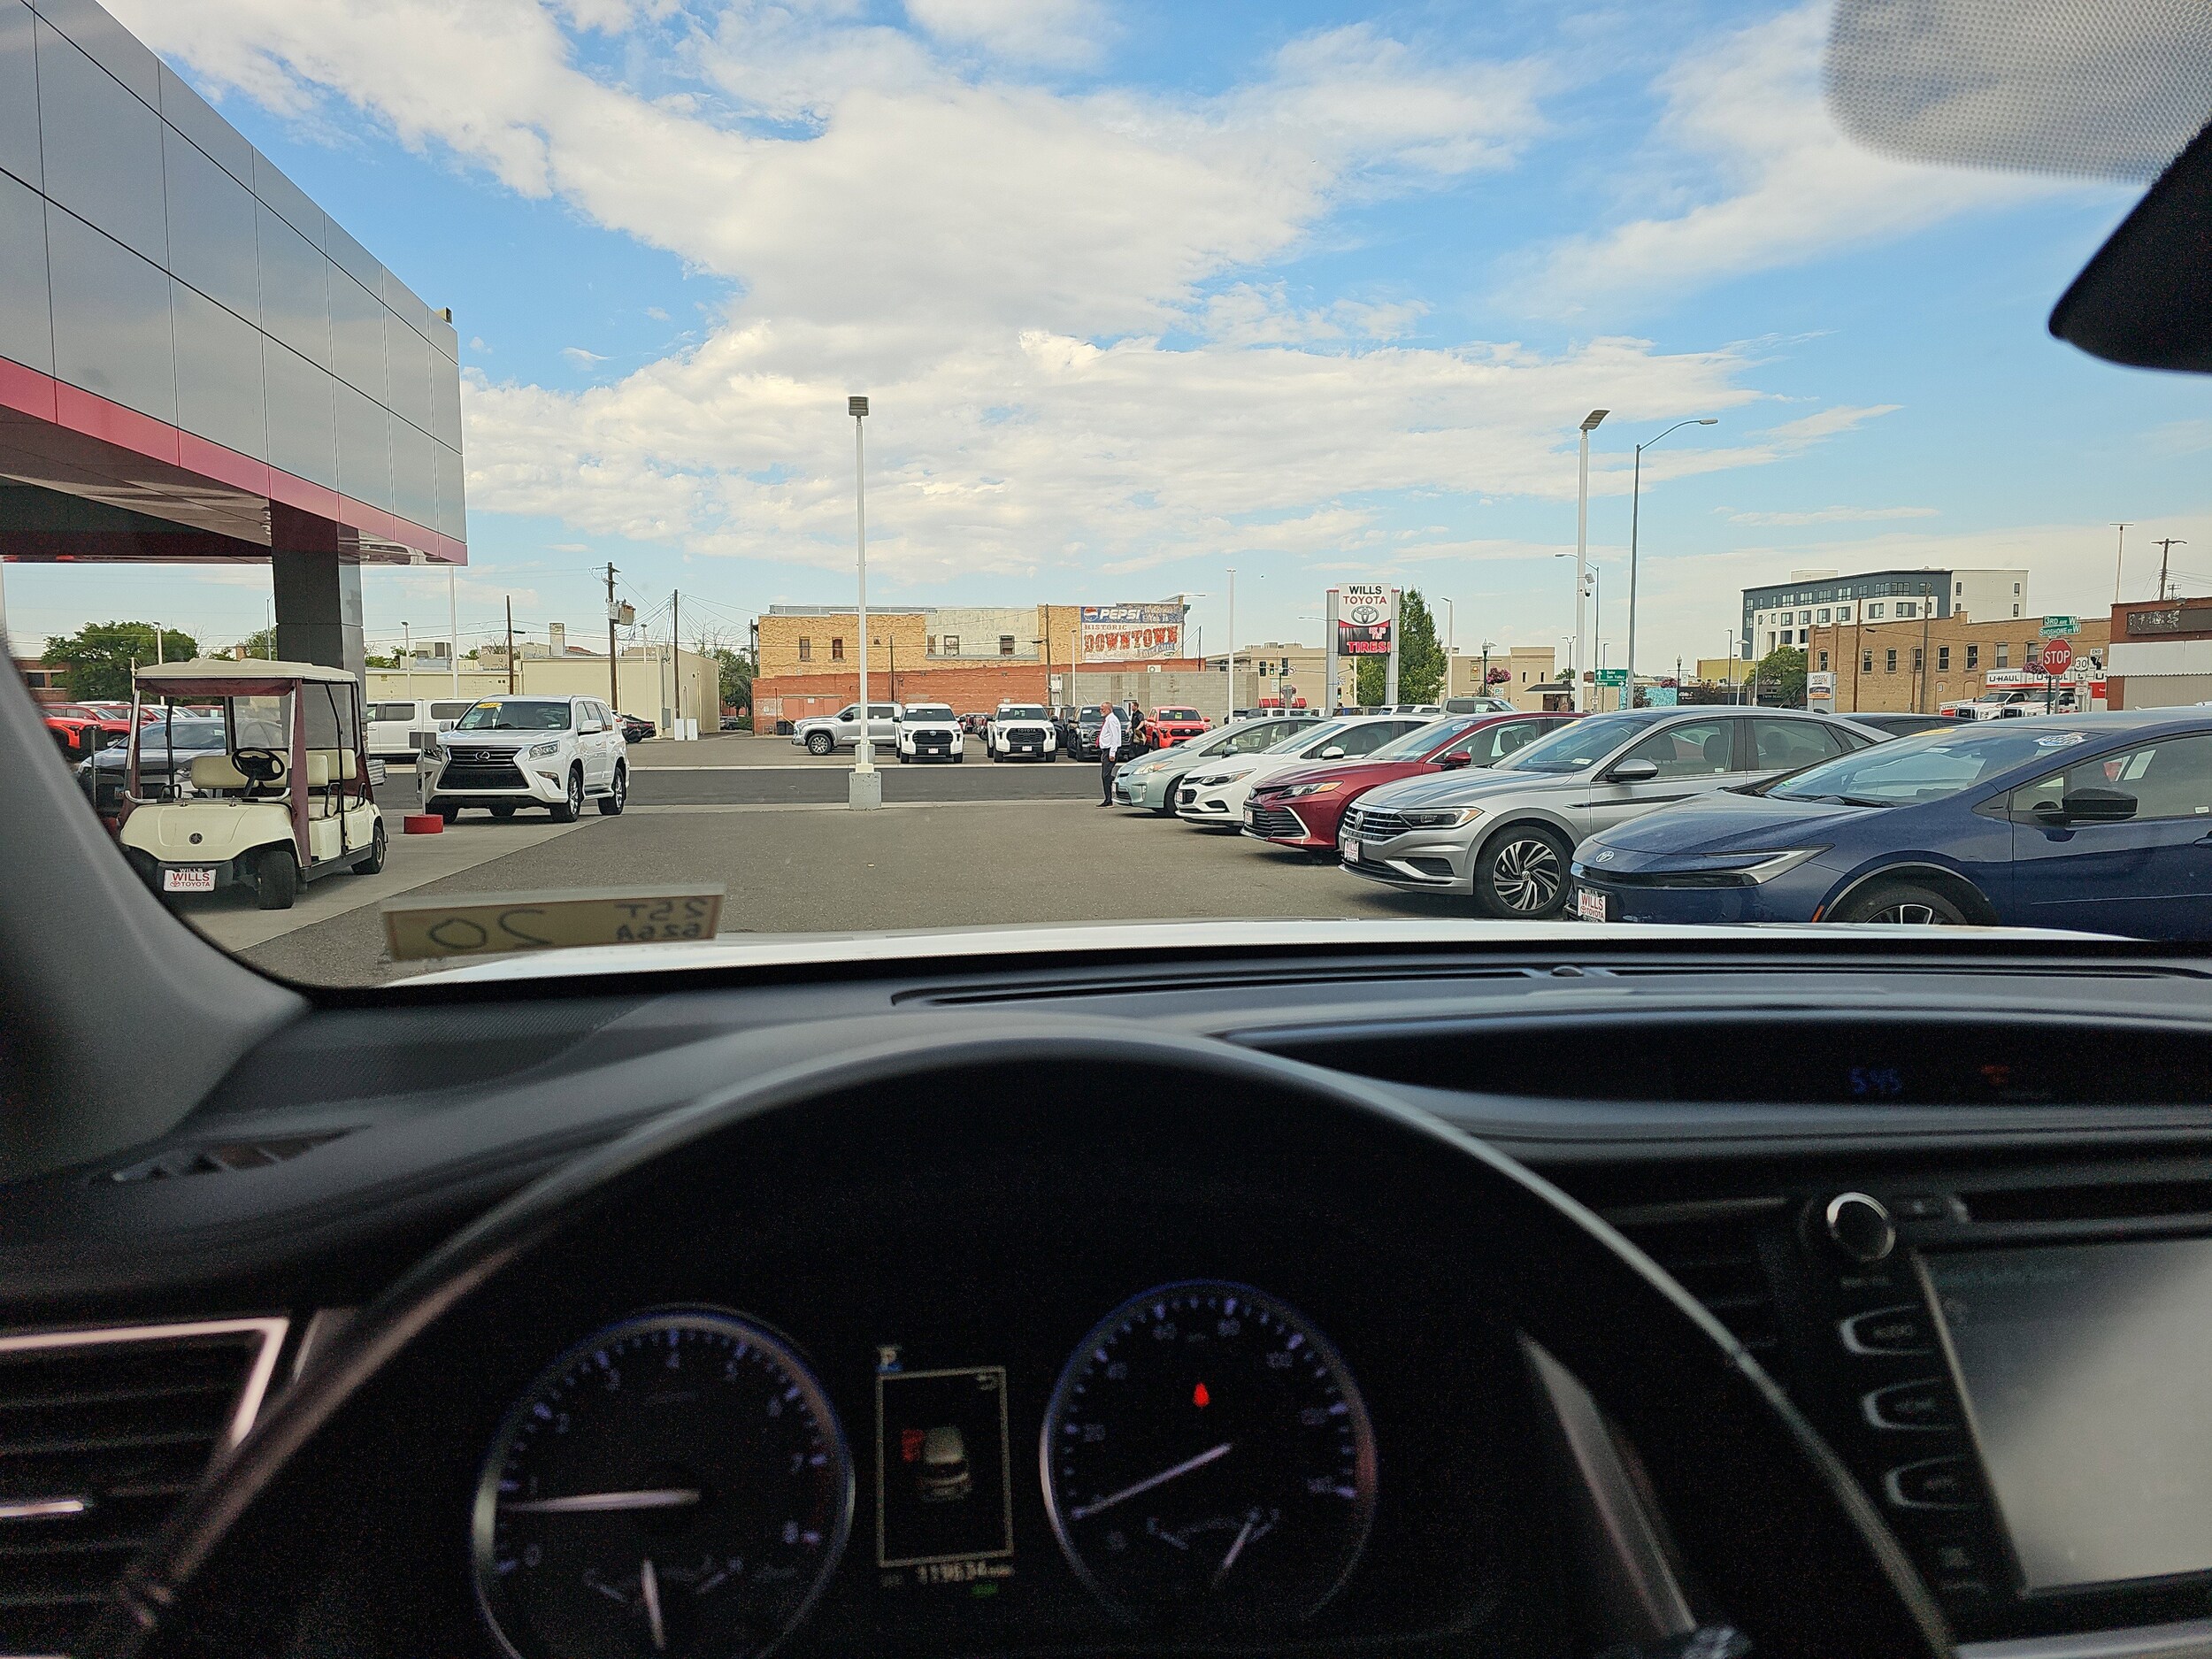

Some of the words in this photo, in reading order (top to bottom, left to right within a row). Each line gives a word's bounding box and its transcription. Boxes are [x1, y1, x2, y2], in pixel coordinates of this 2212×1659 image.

[1349, 586, 1382, 595] WILLS
[1343, 595, 1387, 604] TOYOTA
[1099, 608, 1141, 619] PEPSI
[2045, 616, 2059, 625] 3RD
[2039, 627, 2068, 636] SHOSHONE
[1085, 626, 1178, 653] DOWNTOWN
[1347, 641, 1391, 653] TIRES!
[2044, 650, 2070, 664] STOP
[2076, 659, 2087, 668] 30
[1582, 894, 1603, 910] WILLS
[1586, 908, 1605, 919] TOYOTA
